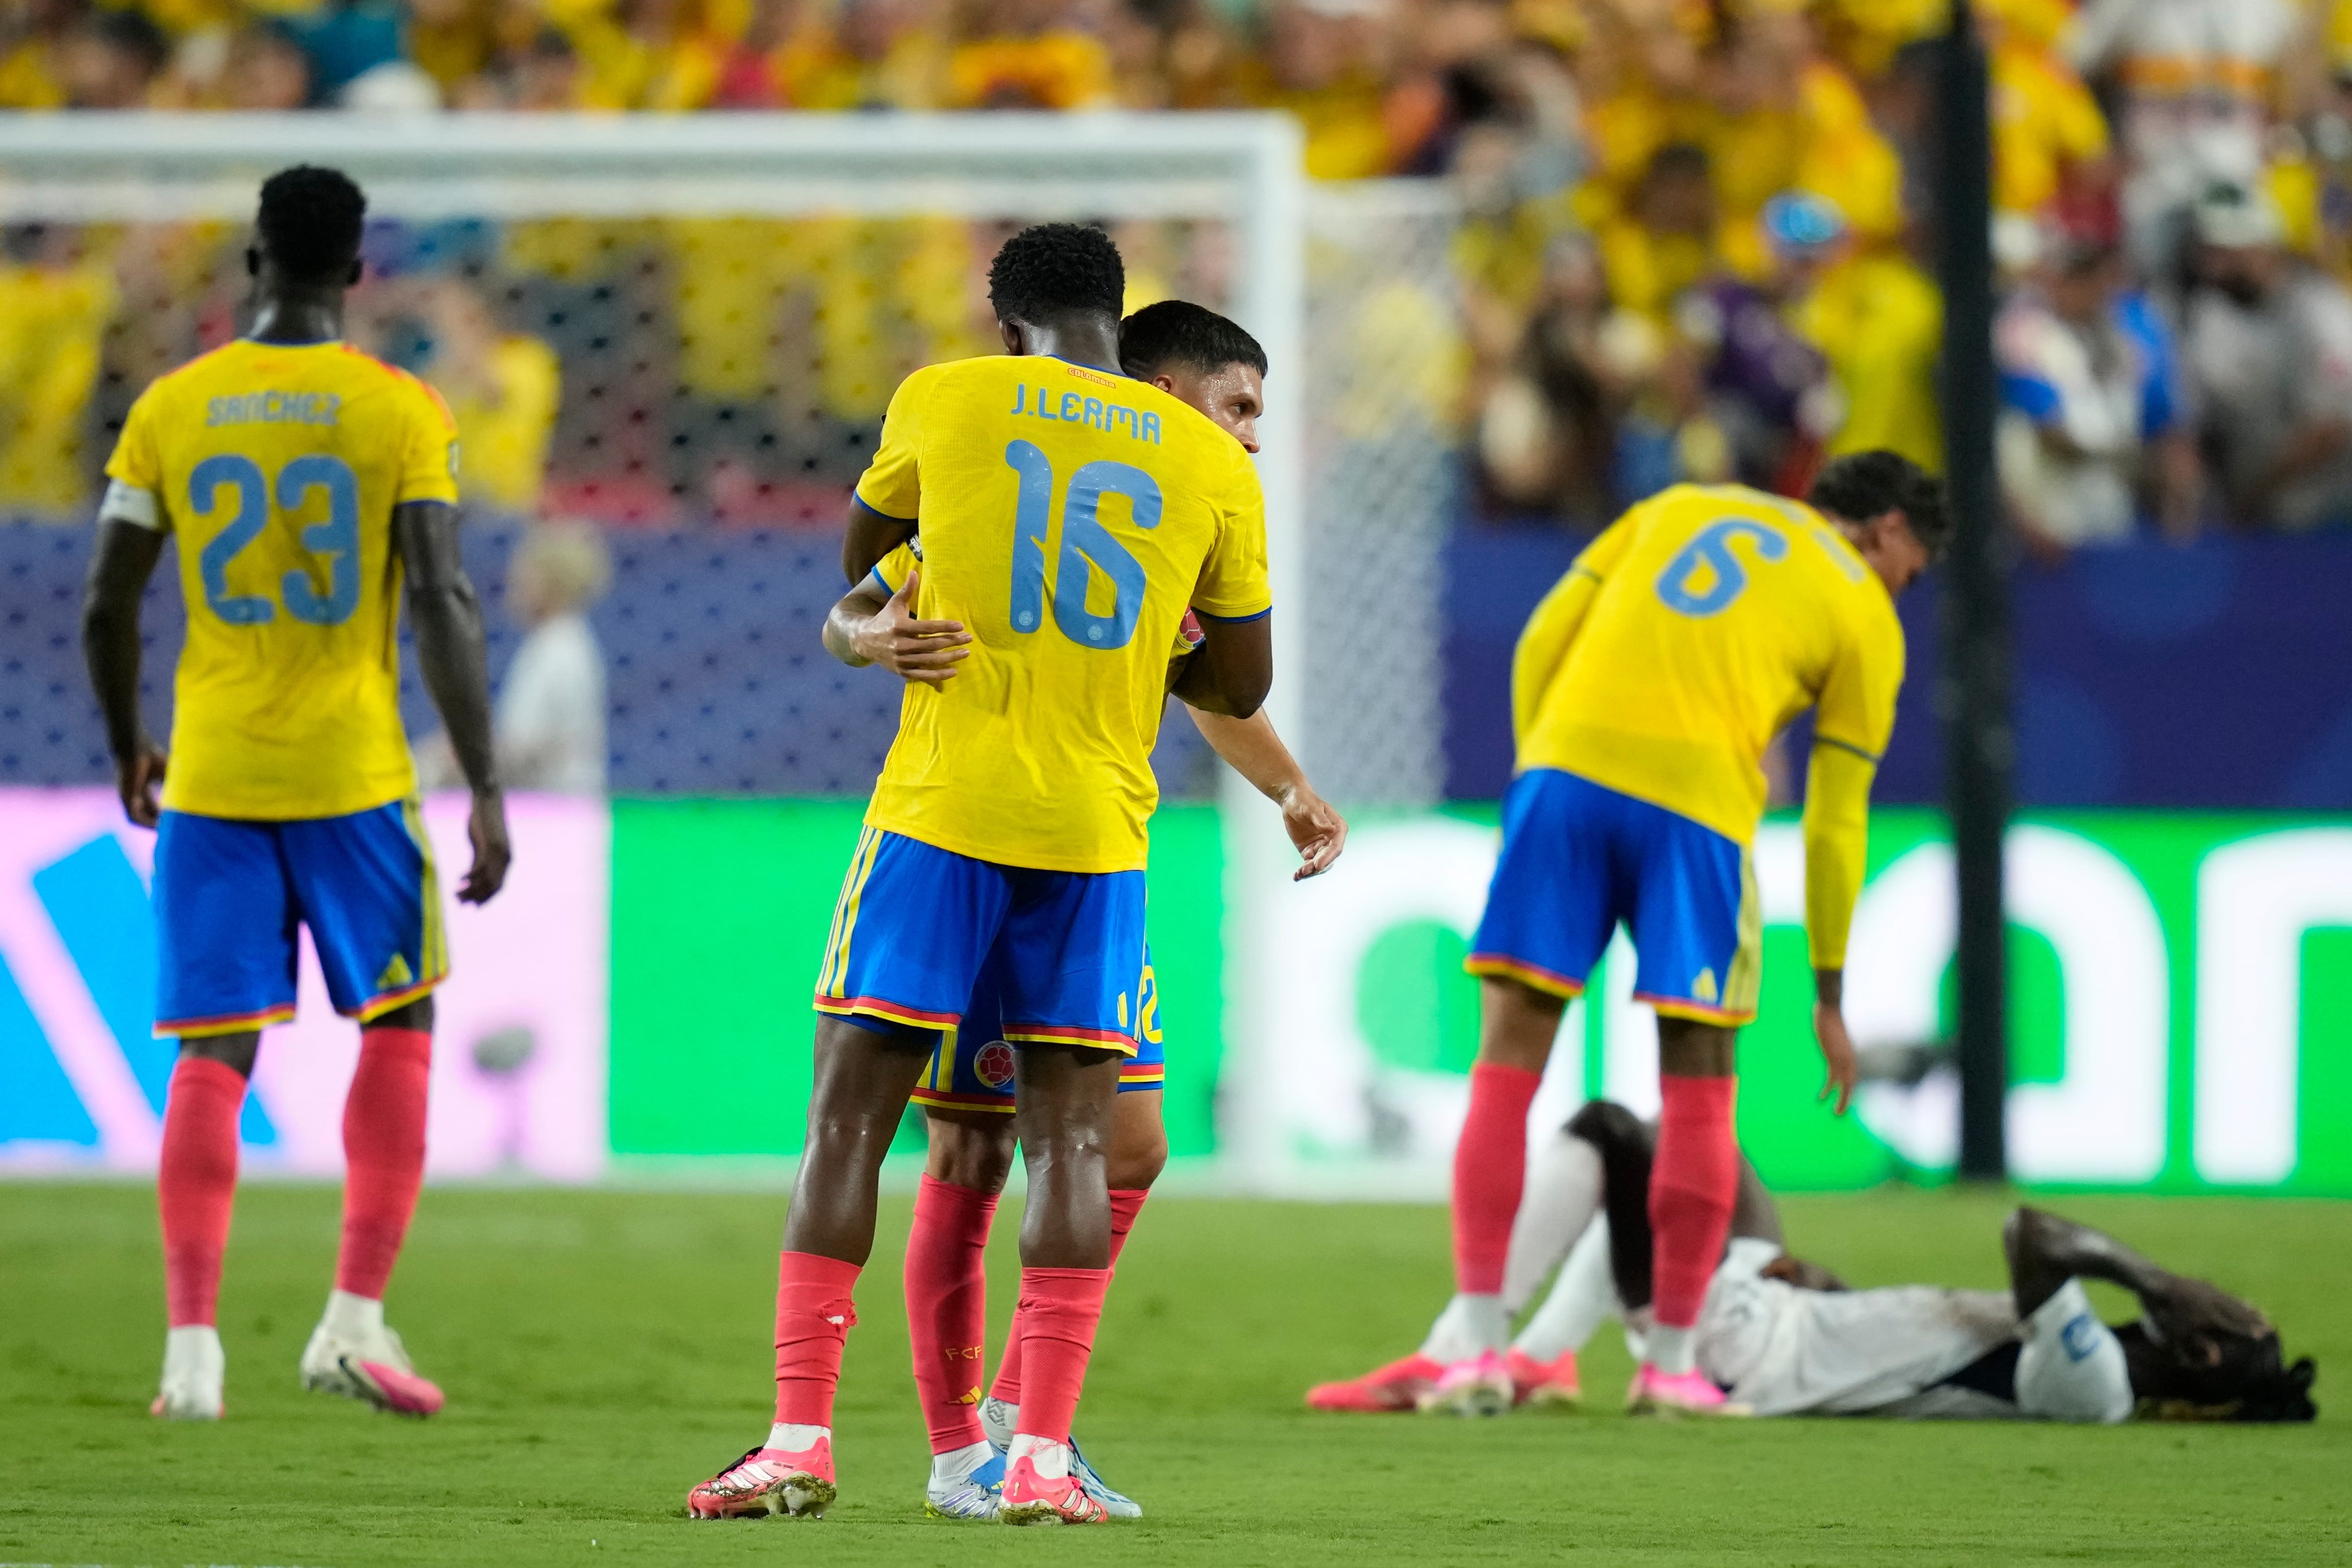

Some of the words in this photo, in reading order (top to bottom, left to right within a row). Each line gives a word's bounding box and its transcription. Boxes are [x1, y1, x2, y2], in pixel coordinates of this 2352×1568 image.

[207, 389, 342, 427] SANCHEZ
[1012, 384, 1160, 444] J.LERMA
[189, 455, 360, 624] 23
[1006, 439, 1162, 649] 16
[1656, 518, 1787, 616] 6
[946, 1345, 982, 1360] FCF
